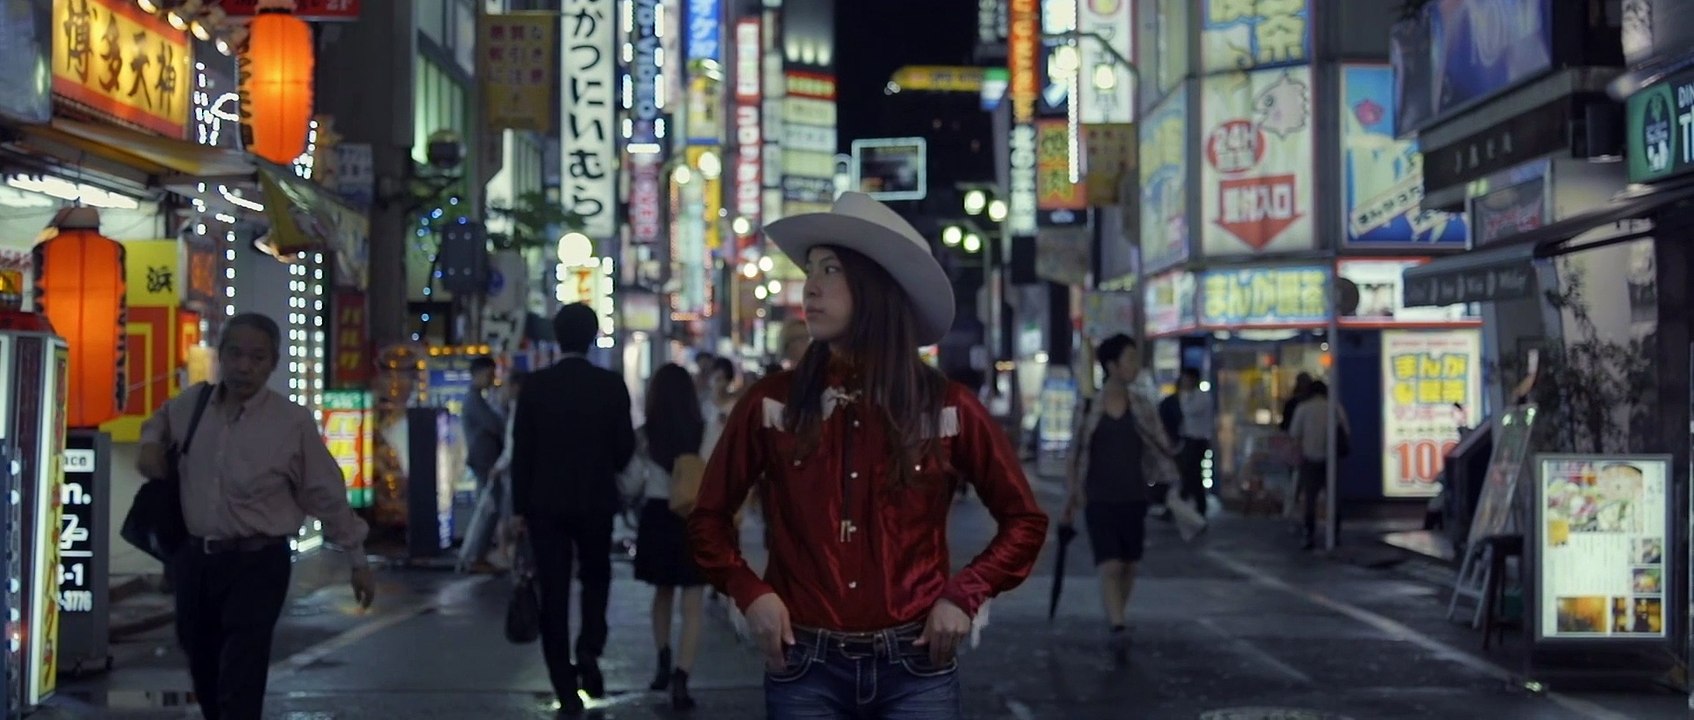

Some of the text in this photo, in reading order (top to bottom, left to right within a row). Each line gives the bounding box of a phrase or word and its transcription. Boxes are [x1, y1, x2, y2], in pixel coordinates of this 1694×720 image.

[63, 4, 177, 115] 博多天神
[568, 0, 605, 217] かつにいむら
[1222, 183, 1293, 222] 受付入口
[146, 266, 173, 293] 浜
[1206, 271, 1326, 317] まんが喫茶
